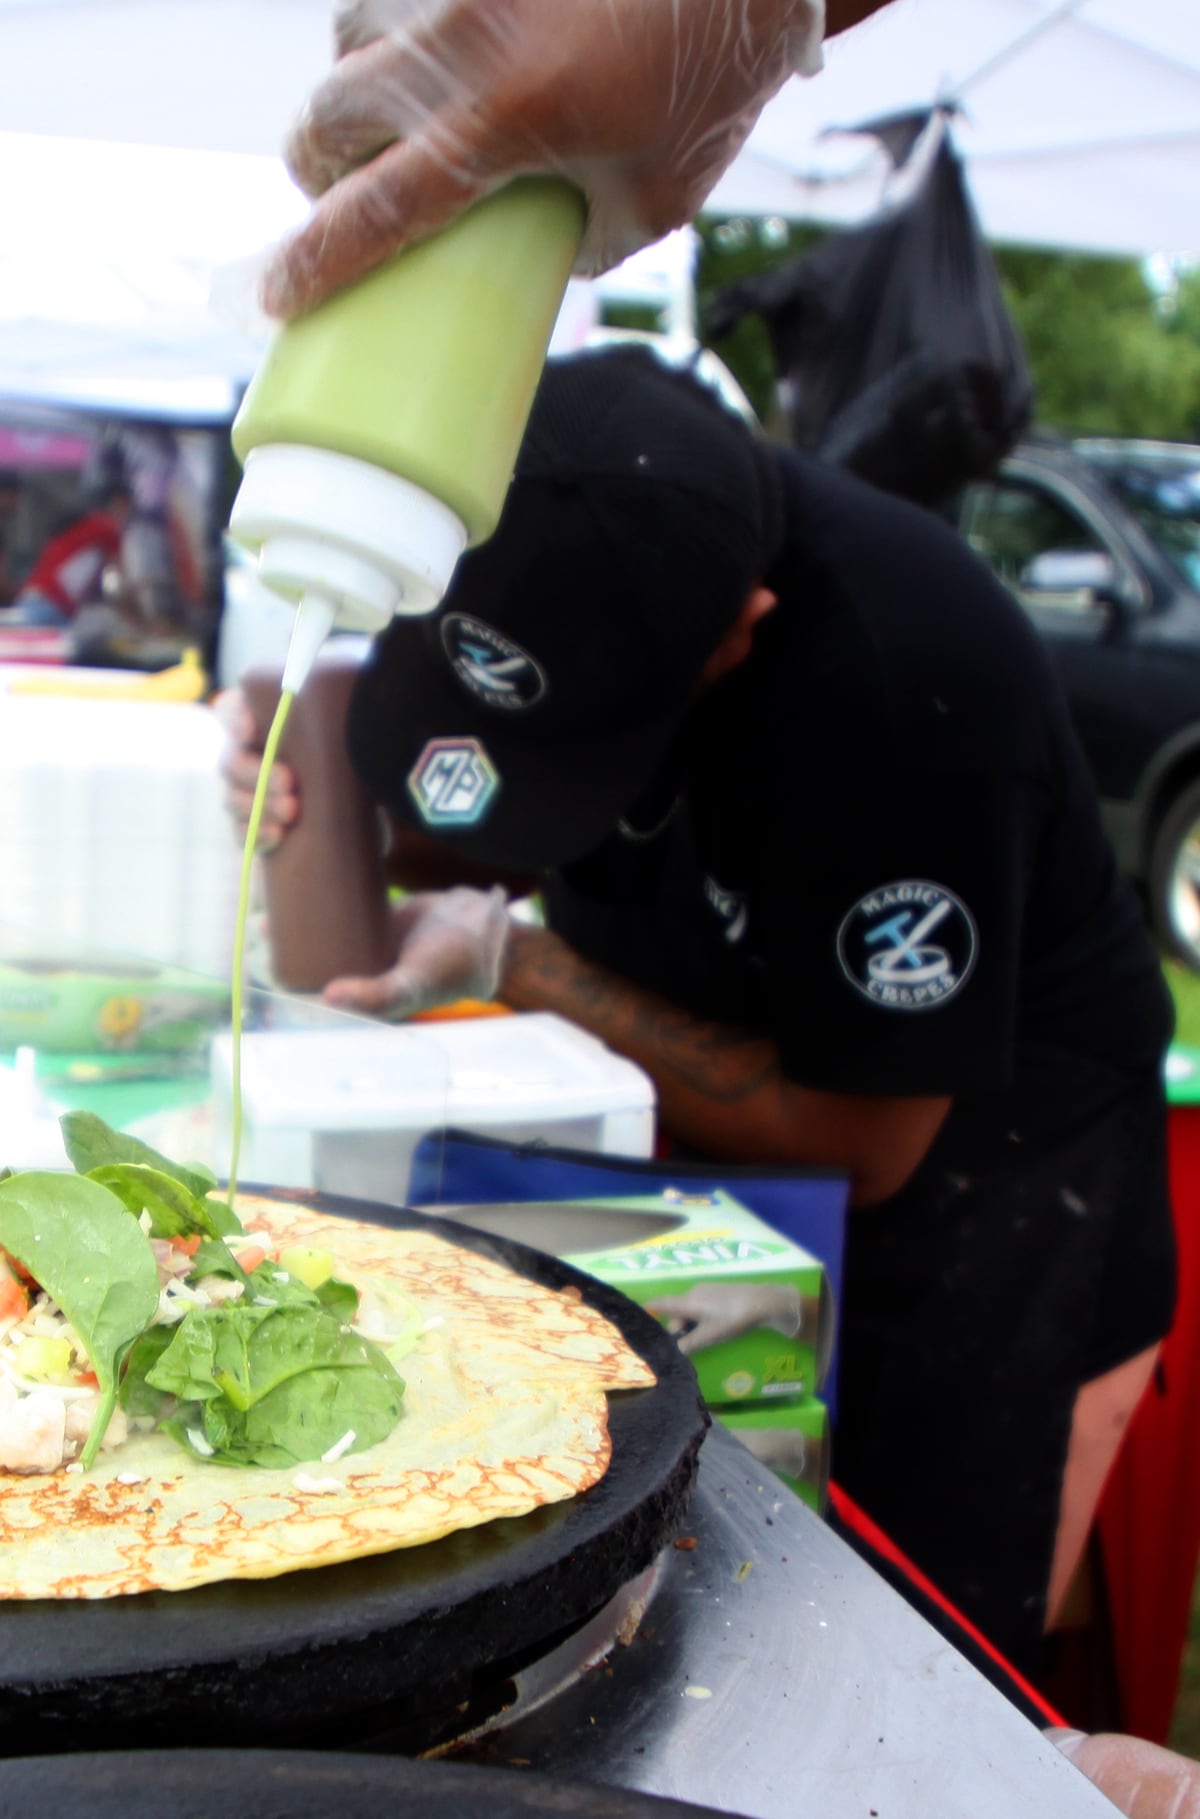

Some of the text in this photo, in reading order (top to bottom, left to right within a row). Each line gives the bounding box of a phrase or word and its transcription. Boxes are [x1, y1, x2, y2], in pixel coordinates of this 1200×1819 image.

[860, 885, 940, 917] MAGIC
[866, 974, 956, 1004] CREPES
[607, 1241, 773, 1271] VINYL
[762, 1354, 804, 1382] XL
